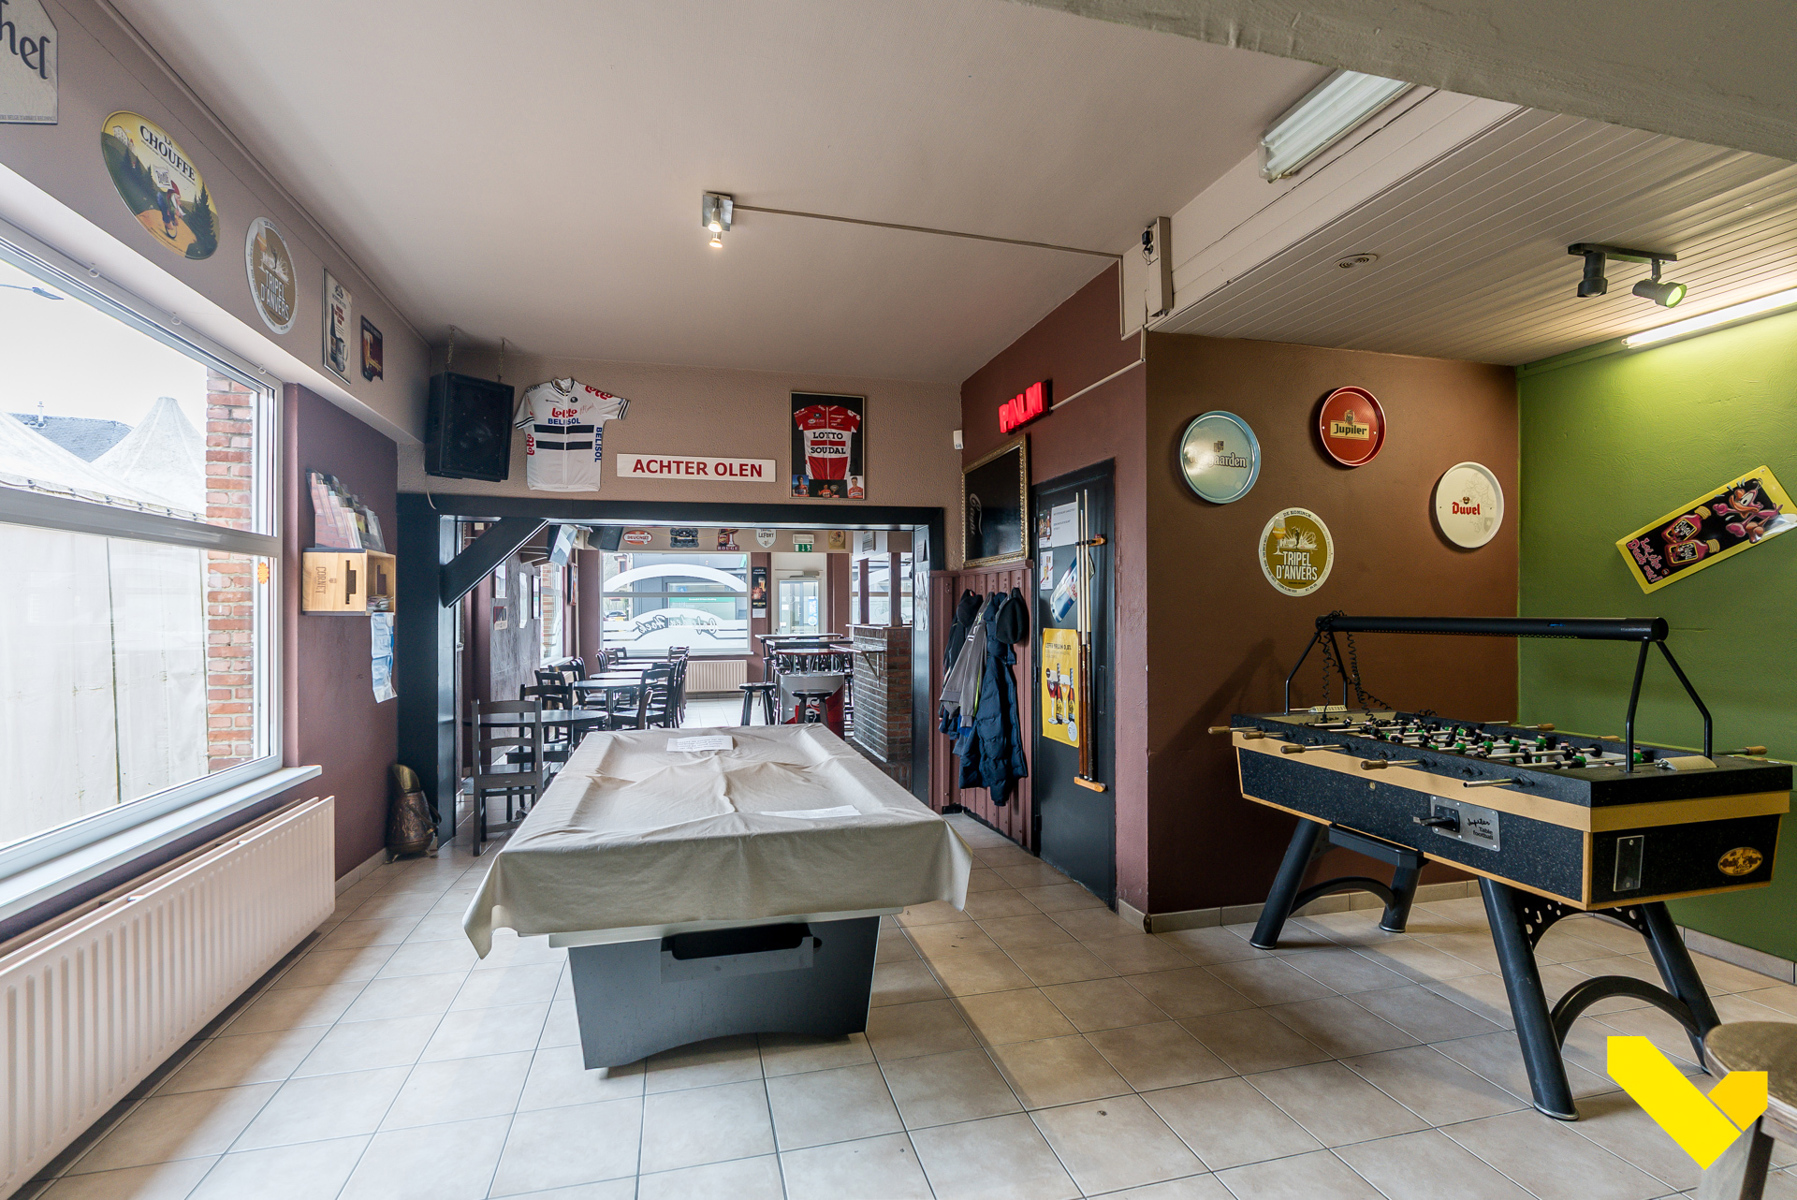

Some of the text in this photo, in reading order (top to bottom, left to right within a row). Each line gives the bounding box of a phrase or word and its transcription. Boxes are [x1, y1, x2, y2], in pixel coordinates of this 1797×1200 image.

[140, 125, 195, 181] CHOUFFE
[265, 269, 286, 302] TRIPEL
[260, 282, 290, 321] D'ANVERS
[999, 382, 1043, 433] PALM
[812, 431, 844, 440] LOTTO
[1333, 423, 1368, 436] Jupiler
[594, 426, 603, 463] BELISOL
[810, 446, 846, 455] SOUDAL
[632, 459, 763, 478] ACHTER OLEN
[1192, 452, 1247, 469] gaarden
[1451, 501, 1481, 516] Duvel
[1282, 550, 1312, 567] TRIPEL
[315, 566, 326, 594] CORNET
[1276, 564, 1318, 581] D'ANVERS
